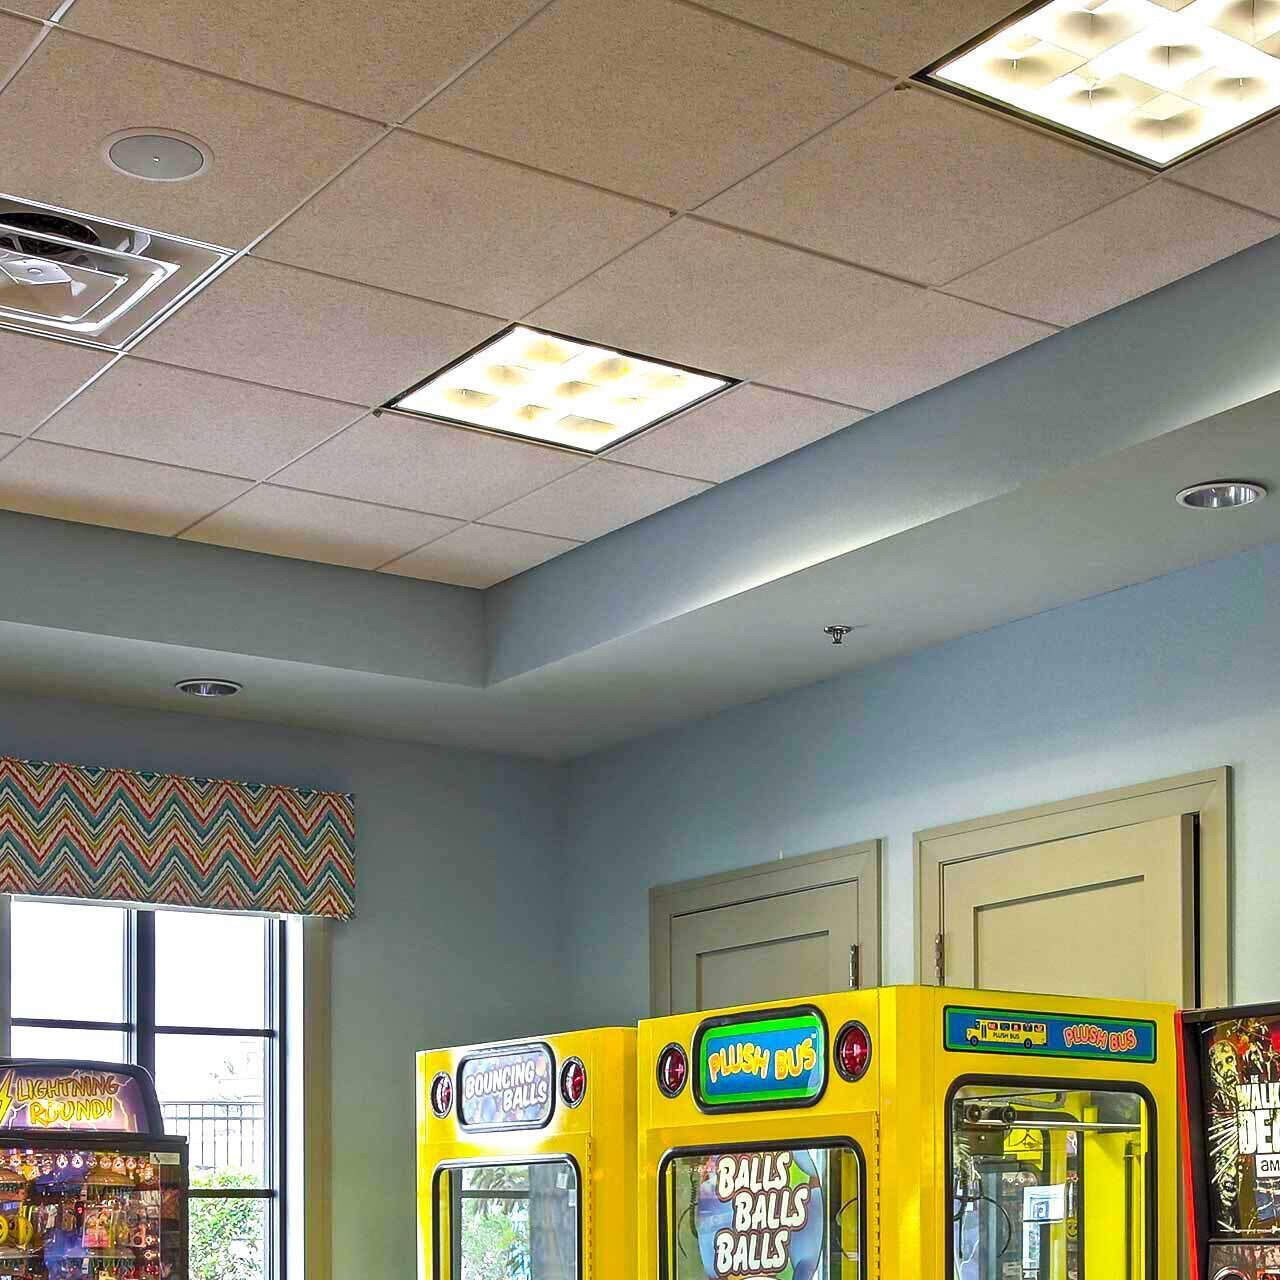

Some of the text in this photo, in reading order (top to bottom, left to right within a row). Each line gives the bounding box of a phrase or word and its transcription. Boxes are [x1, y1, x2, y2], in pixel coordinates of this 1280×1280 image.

[1064, 1024, 1138, 1053] PLUSH BUS
[465, 1060, 535, 1099] BOUNCING
[708, 1037, 817, 1083] PLUSH BUS
[16, 1075, 120, 1102] LIGHTNING
[502, 1080, 548, 1112] BALLS
[30, 1096, 113, 1127] ROUND!
[718, 1151, 791, 1199] BALLS
[734, 1187, 809, 1233] BALLS
[716, 1230, 789, 1274] BALLS
